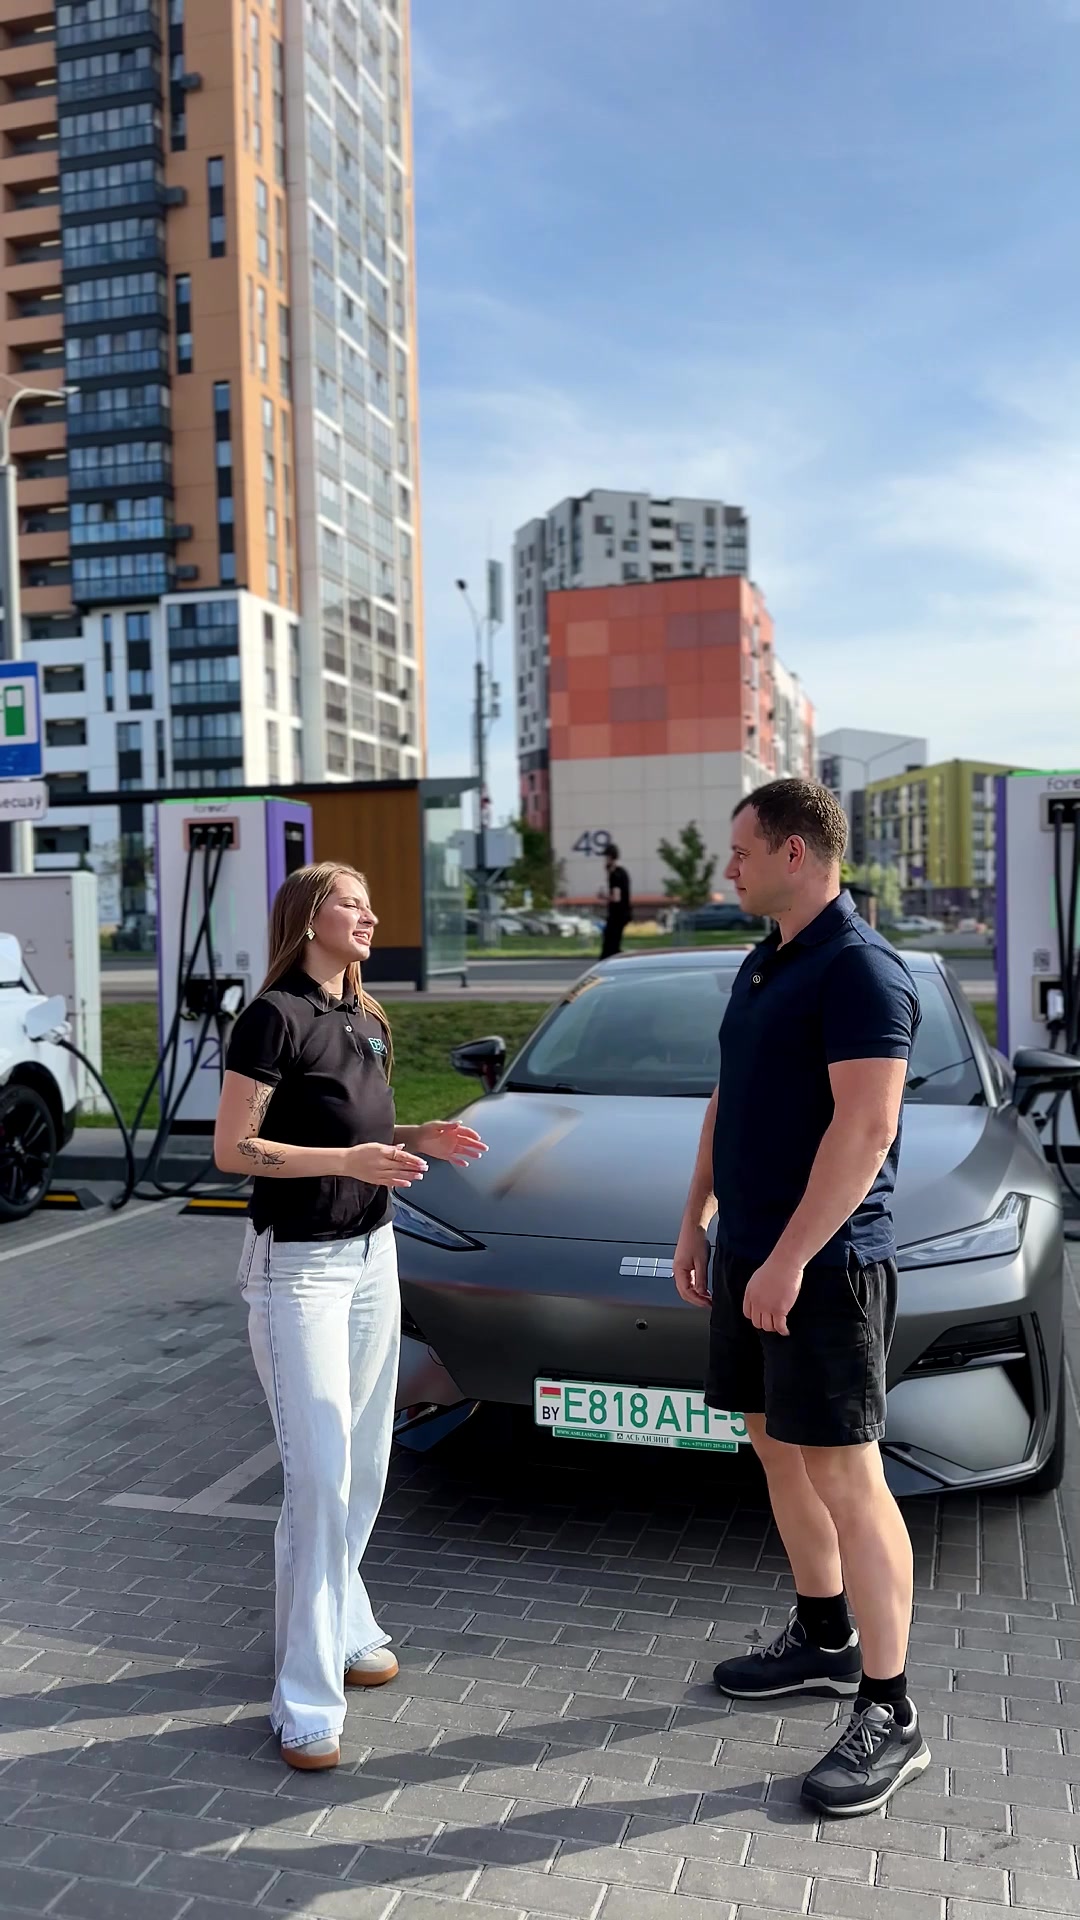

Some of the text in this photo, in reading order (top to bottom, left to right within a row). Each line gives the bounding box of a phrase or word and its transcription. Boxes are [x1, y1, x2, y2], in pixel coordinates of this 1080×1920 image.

[0, 794, 41, 810] есцаў
[572, 829, 612, 857] 49
[183, 1036, 221, 1069] 12
[542, 1405, 560, 1421] BY
